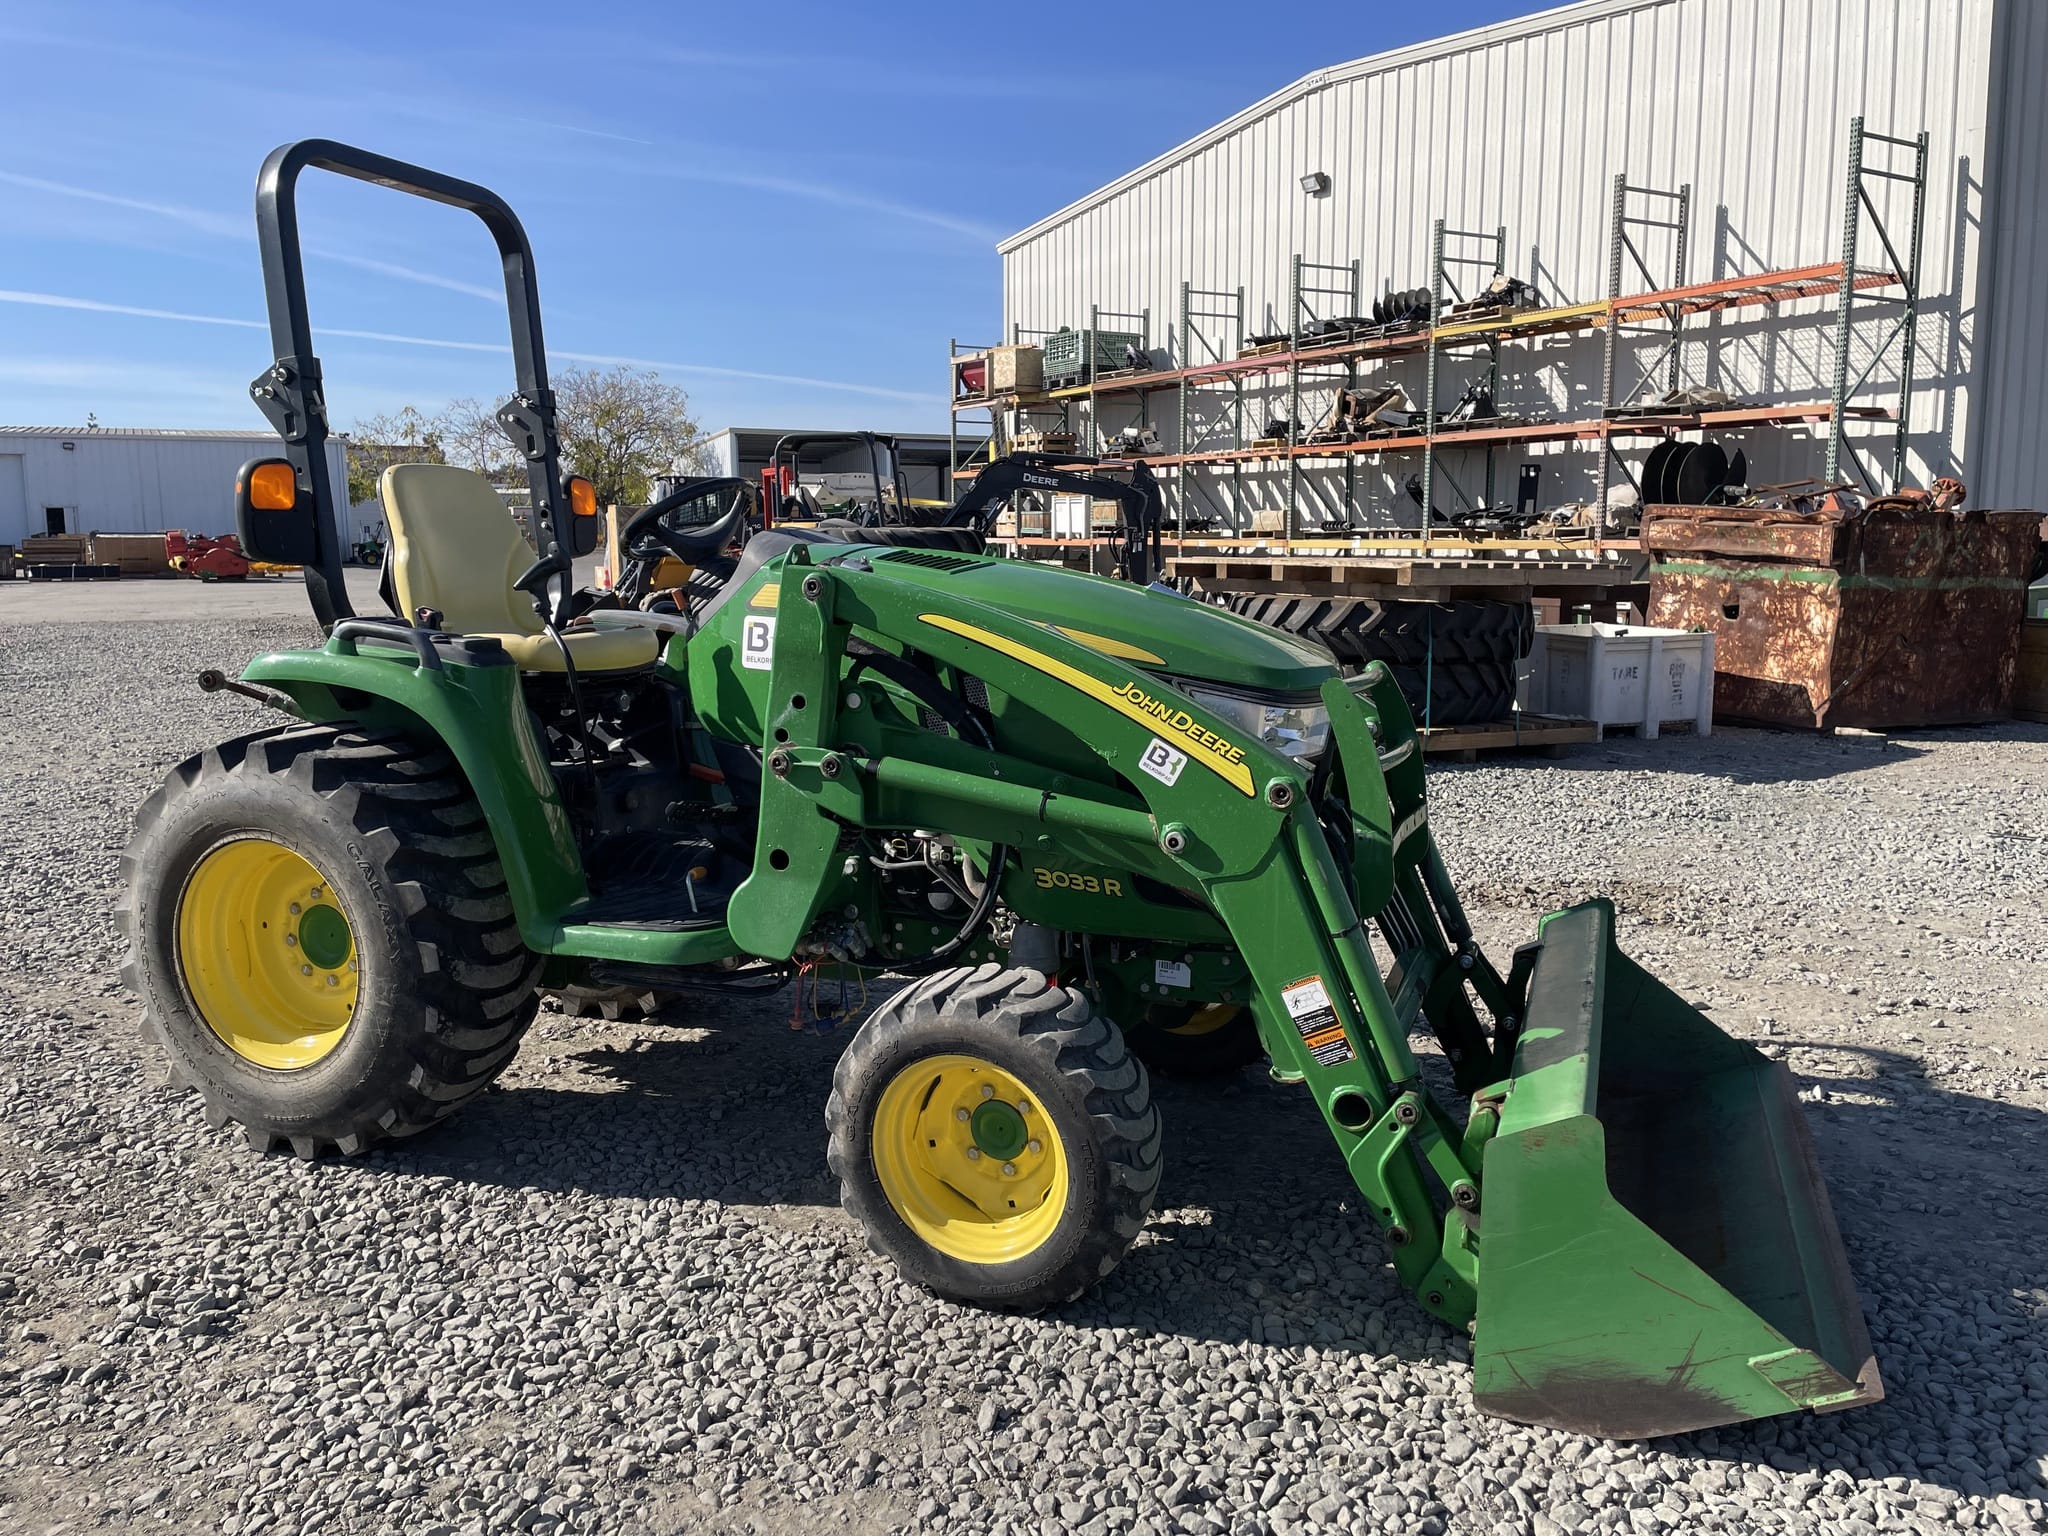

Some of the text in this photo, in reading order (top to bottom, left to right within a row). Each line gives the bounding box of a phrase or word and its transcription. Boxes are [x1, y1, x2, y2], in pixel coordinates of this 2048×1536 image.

[1023, 472, 1059, 487] DEERE
[1112, 681, 1246, 765] JOHN DEERE
[345, 841, 401, 963] GALAXY
